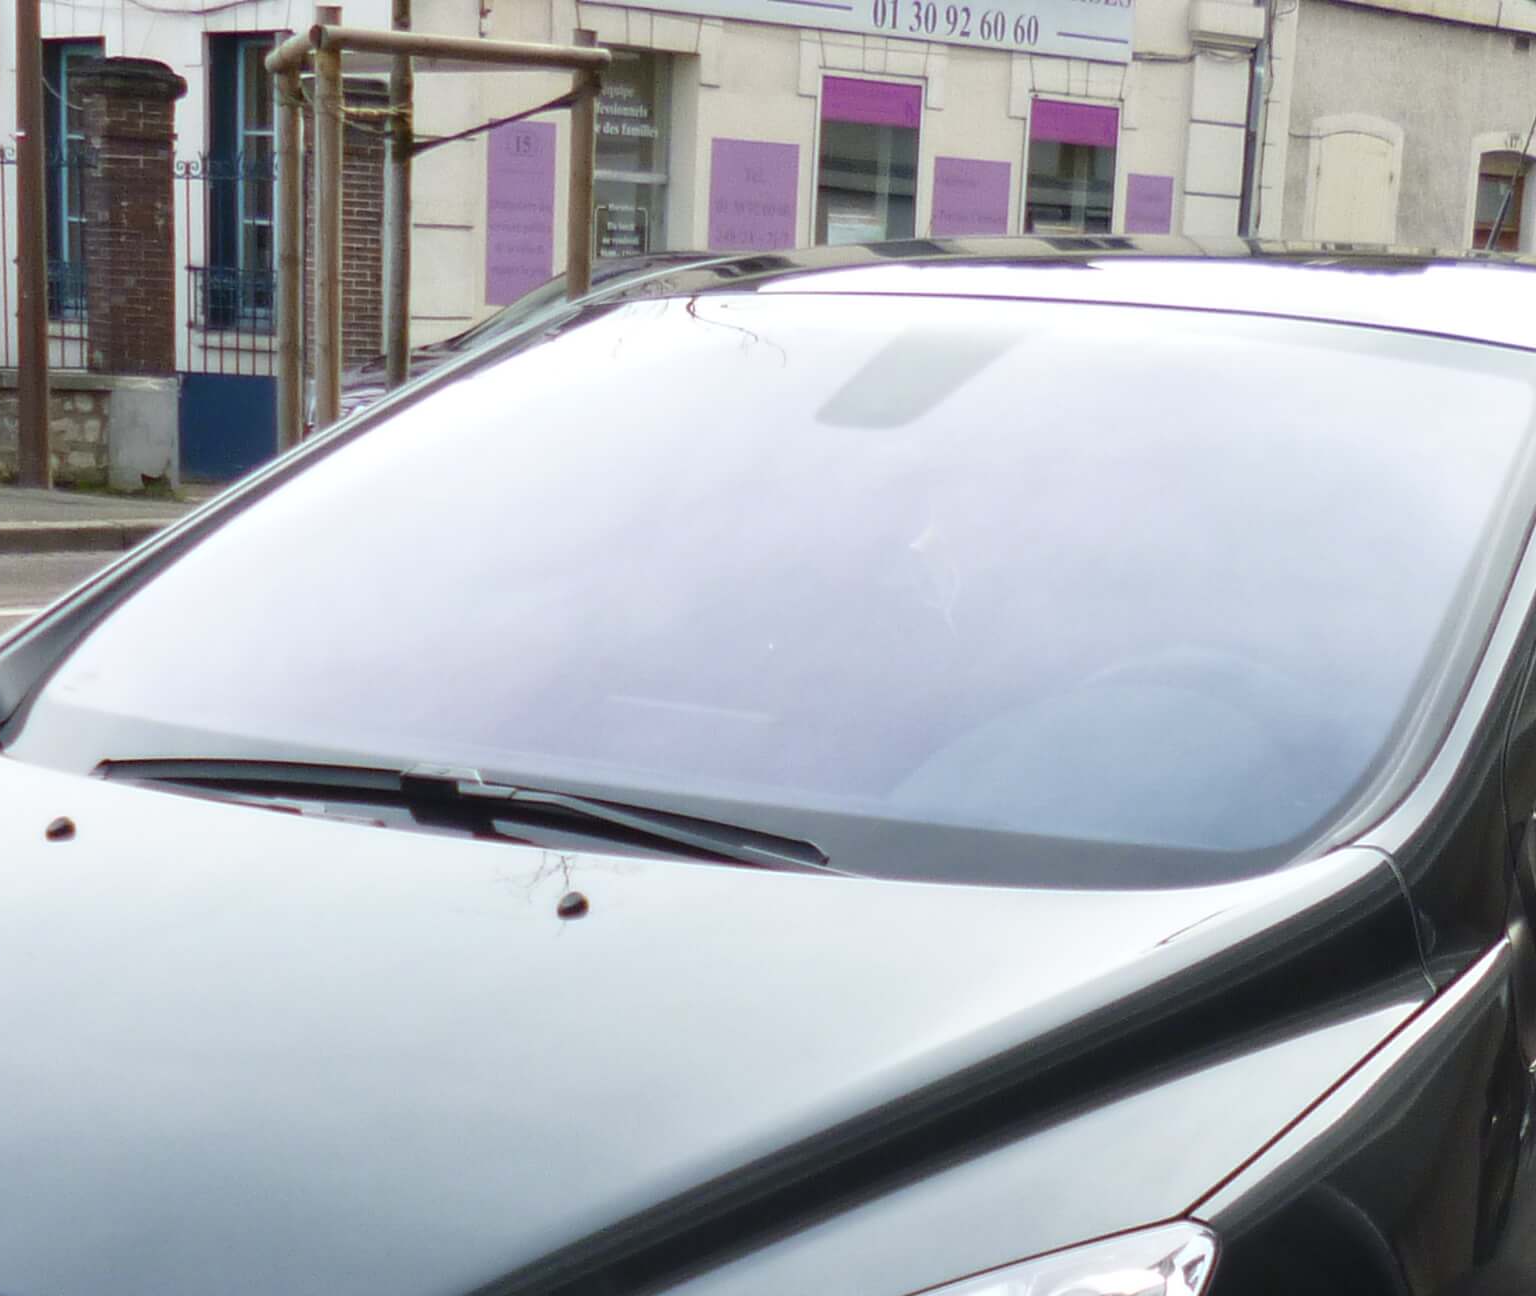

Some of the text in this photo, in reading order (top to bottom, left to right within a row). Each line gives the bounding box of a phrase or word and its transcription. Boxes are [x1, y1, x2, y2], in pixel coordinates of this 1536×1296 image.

[872, 0, 1039, 46] 01 30 92 60 60
